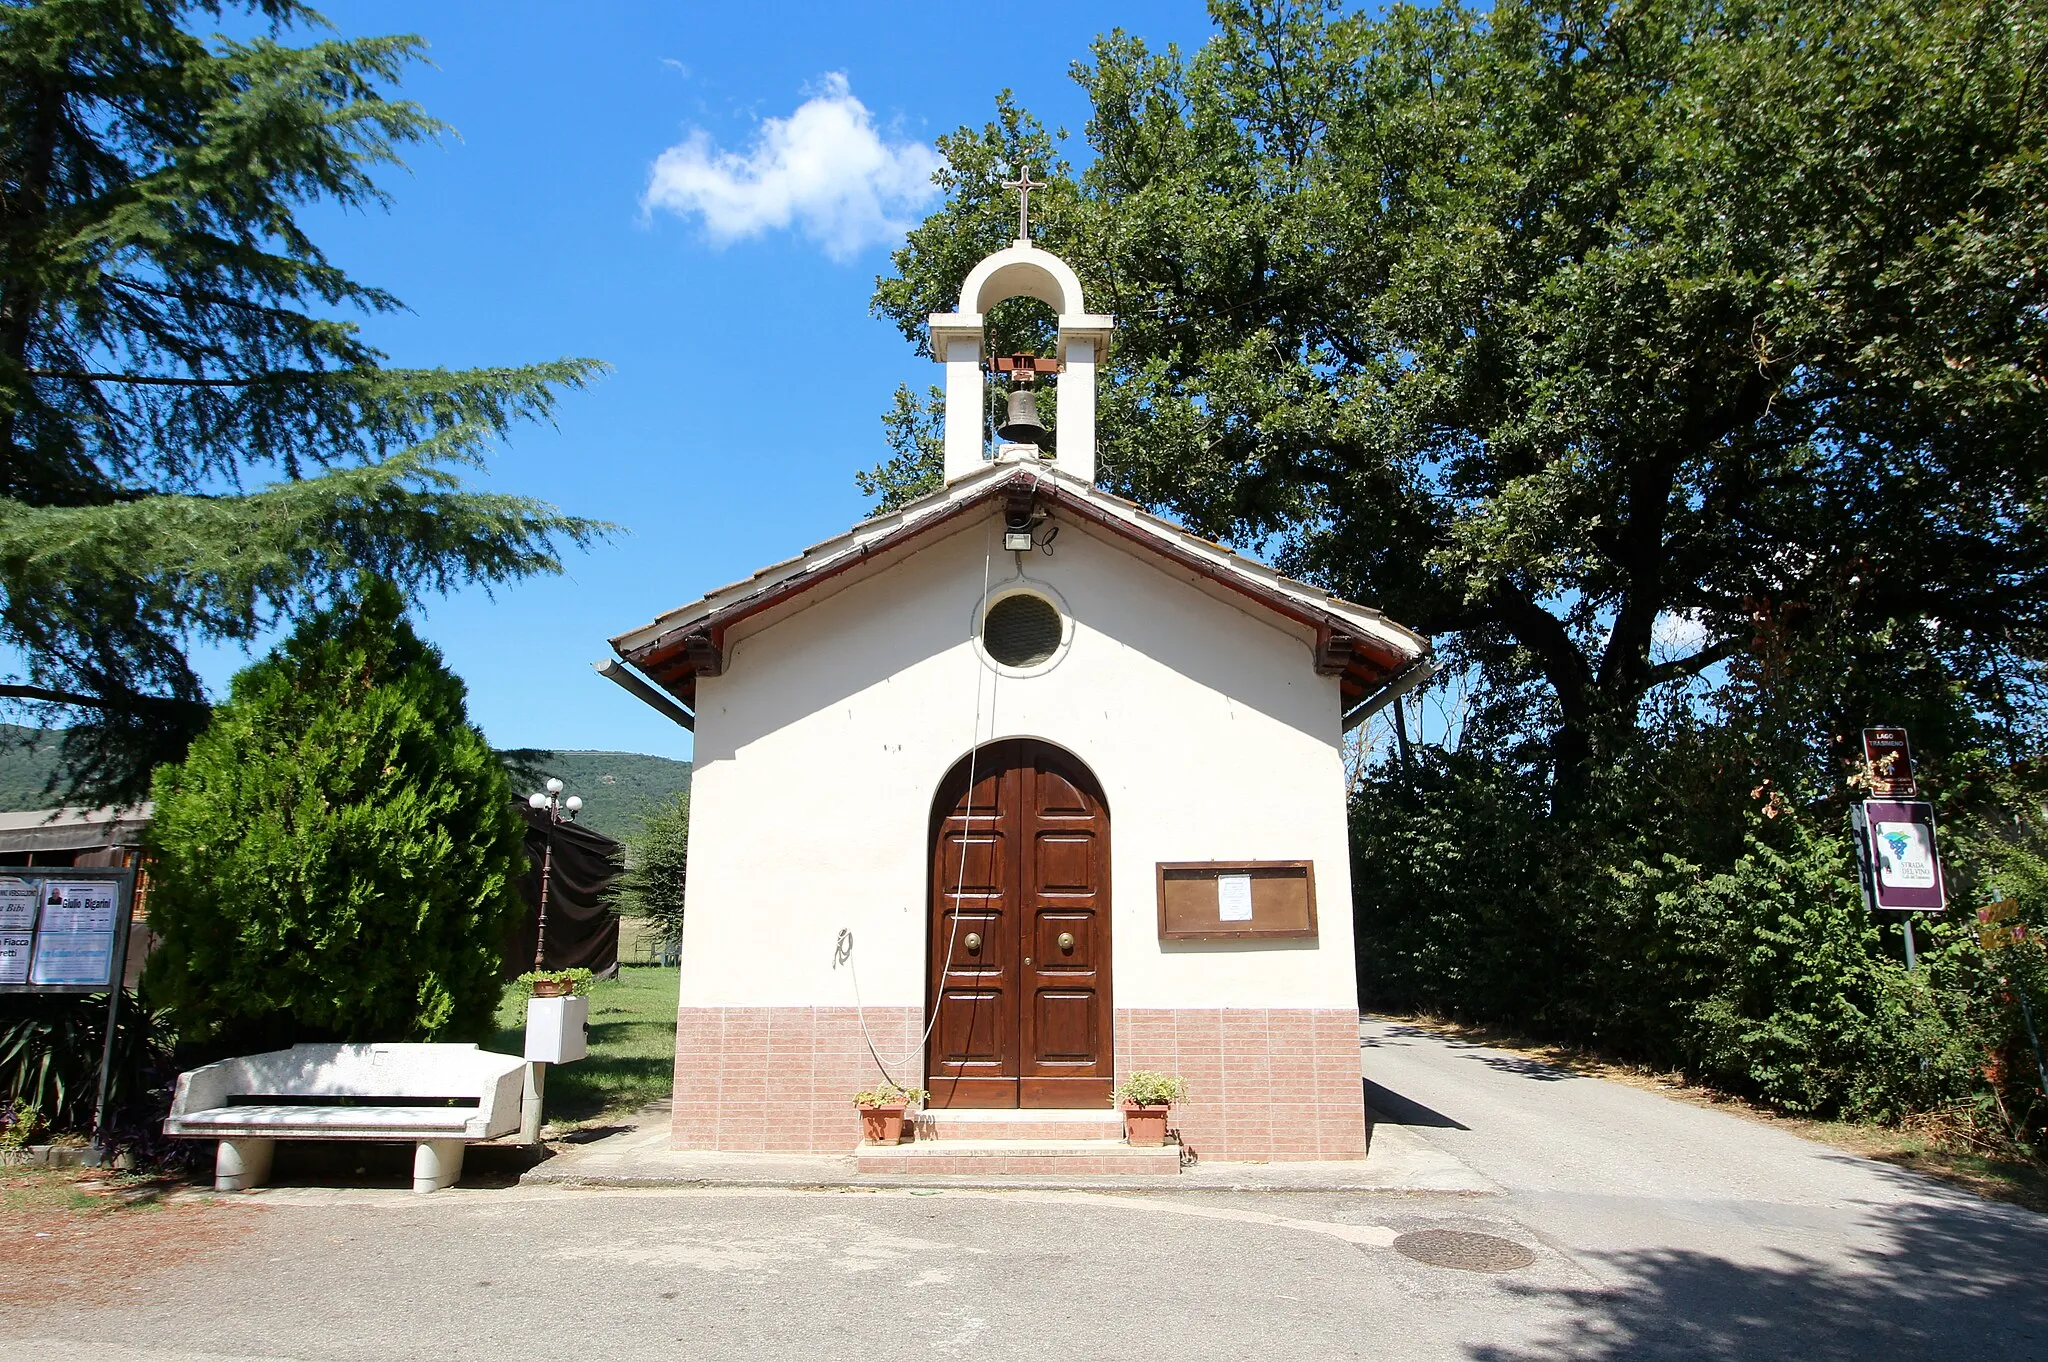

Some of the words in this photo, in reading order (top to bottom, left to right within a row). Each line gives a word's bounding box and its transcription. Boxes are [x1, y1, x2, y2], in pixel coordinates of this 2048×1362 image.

[6, 903, 26, 912] Bibi
[63, 898, 82, 908] Giulio
[85, 898, 112, 910] Bigarini
[3, 938, 29, 946] Fiacca
